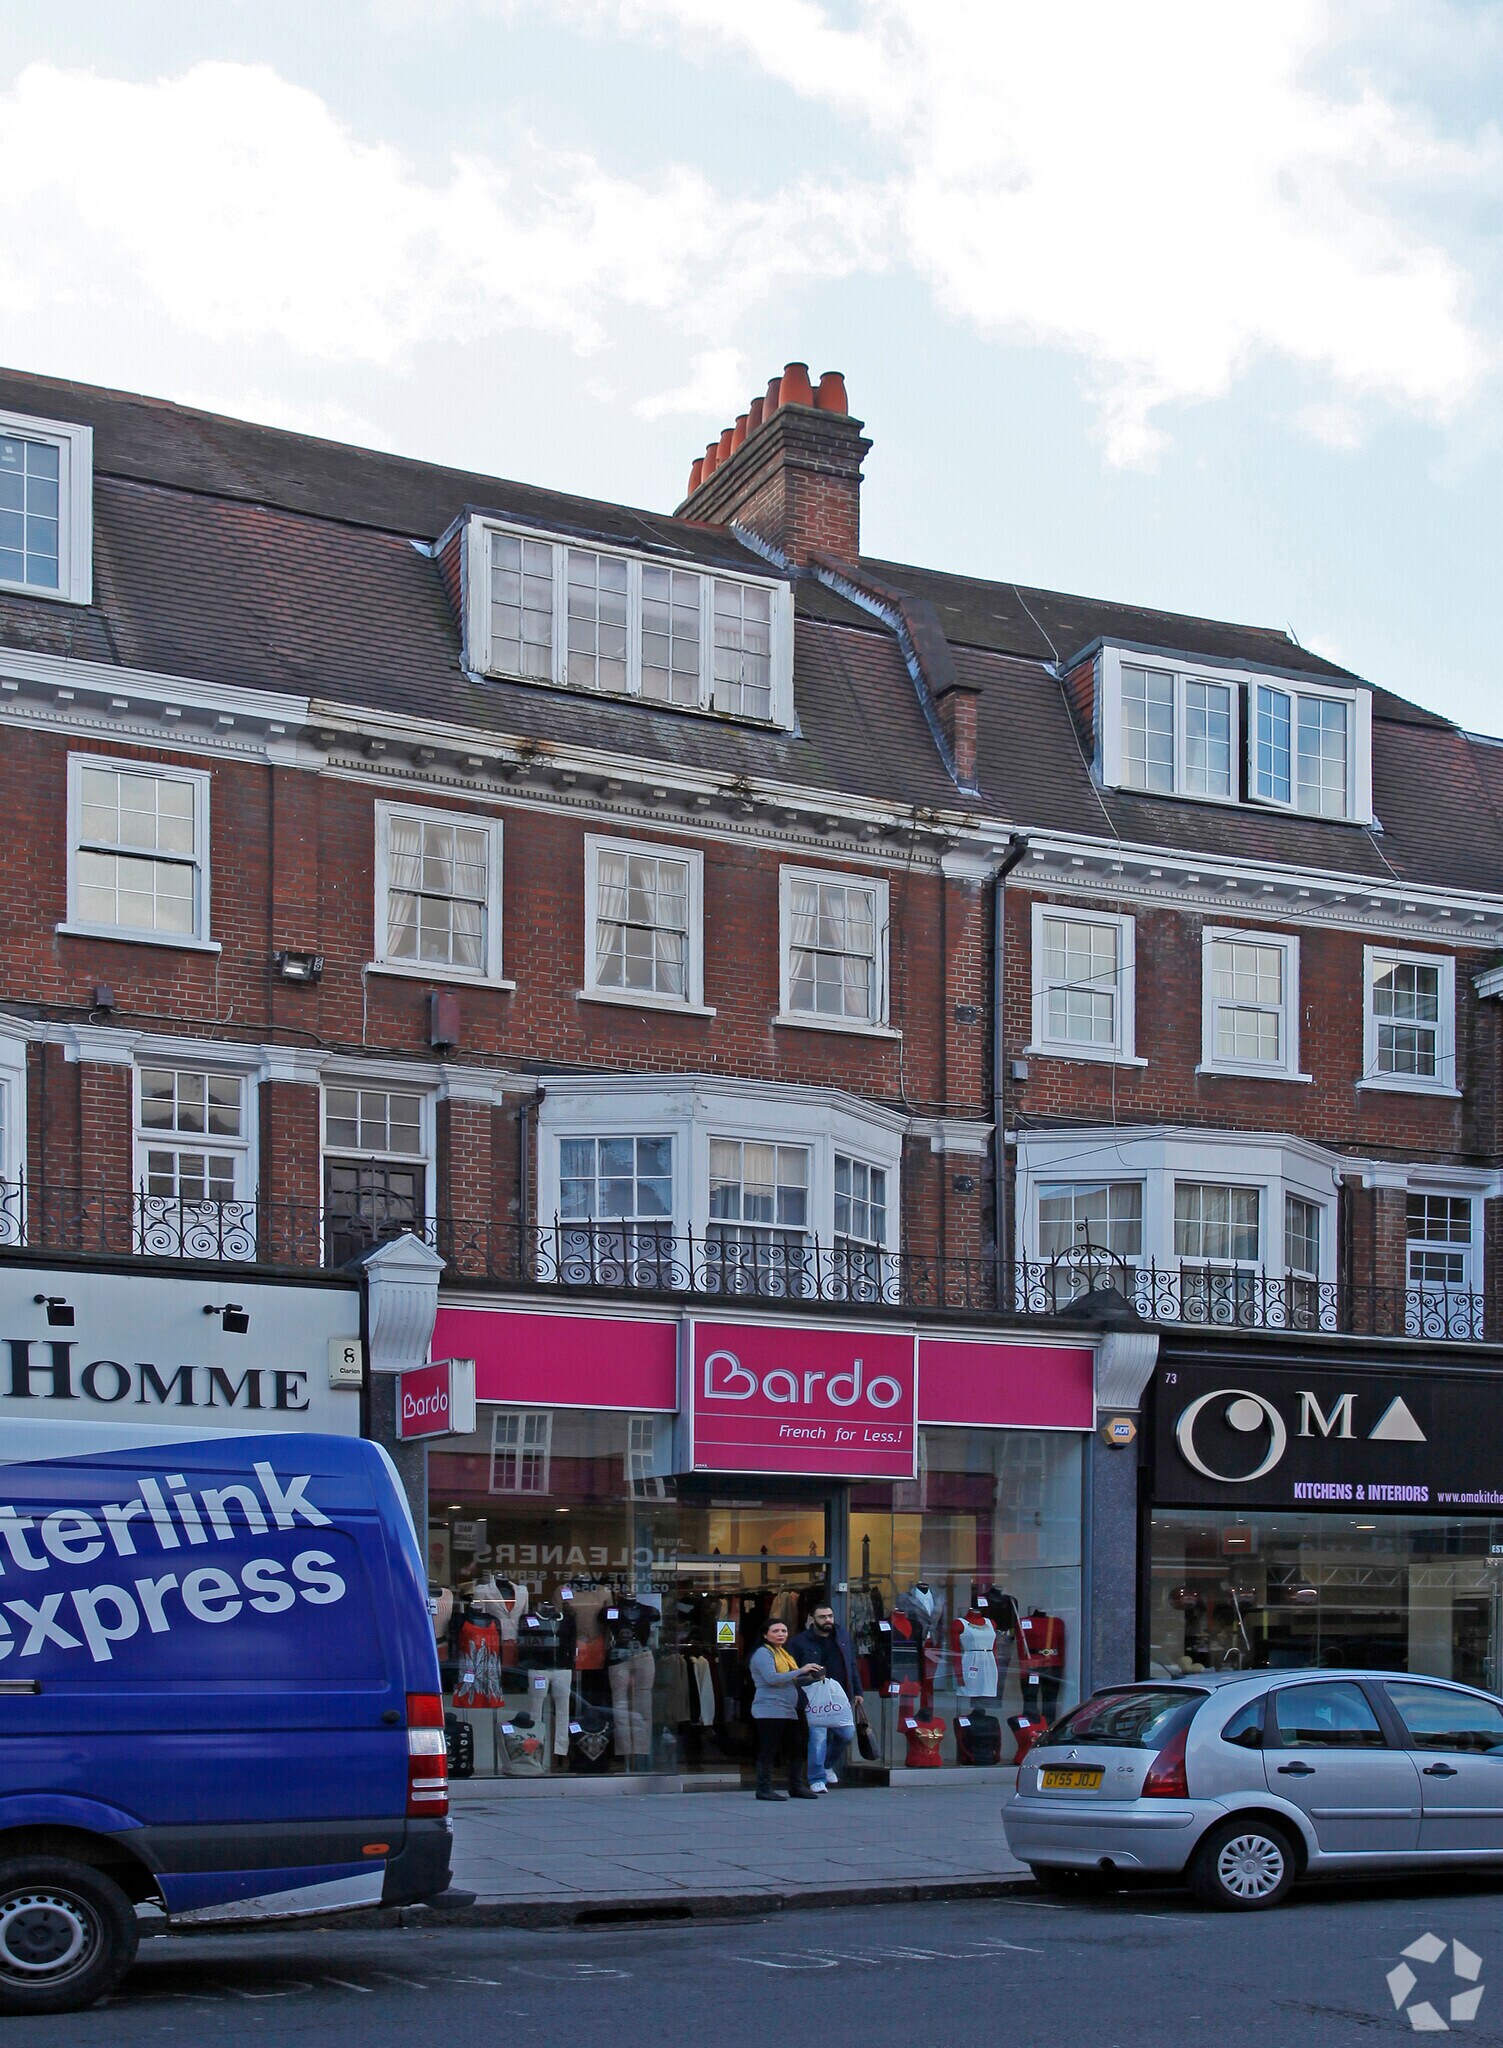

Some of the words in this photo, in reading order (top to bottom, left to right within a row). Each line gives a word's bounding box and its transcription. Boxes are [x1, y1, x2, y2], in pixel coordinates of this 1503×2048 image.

[1, 1338, 311, 1411] HOMME
[704, 1350, 903, 1409] Bardo
[1165, 1372, 1177, 1384] 73
[404, 1385, 448, 1419] Bardo
[779, 1424, 826, 1439] French
[834, 1427, 857, 1442] for
[1114, 1426, 1129, 1435] ADT
[1294, 1482, 1352, 1500] KITCHENS
[1356, 1484, 1365, 1500] &
[1368, 1485, 1429, 1502] INTERIORS
[0, 1461, 333, 1576] terlink
[0, 1550, 346, 1663] xpress
